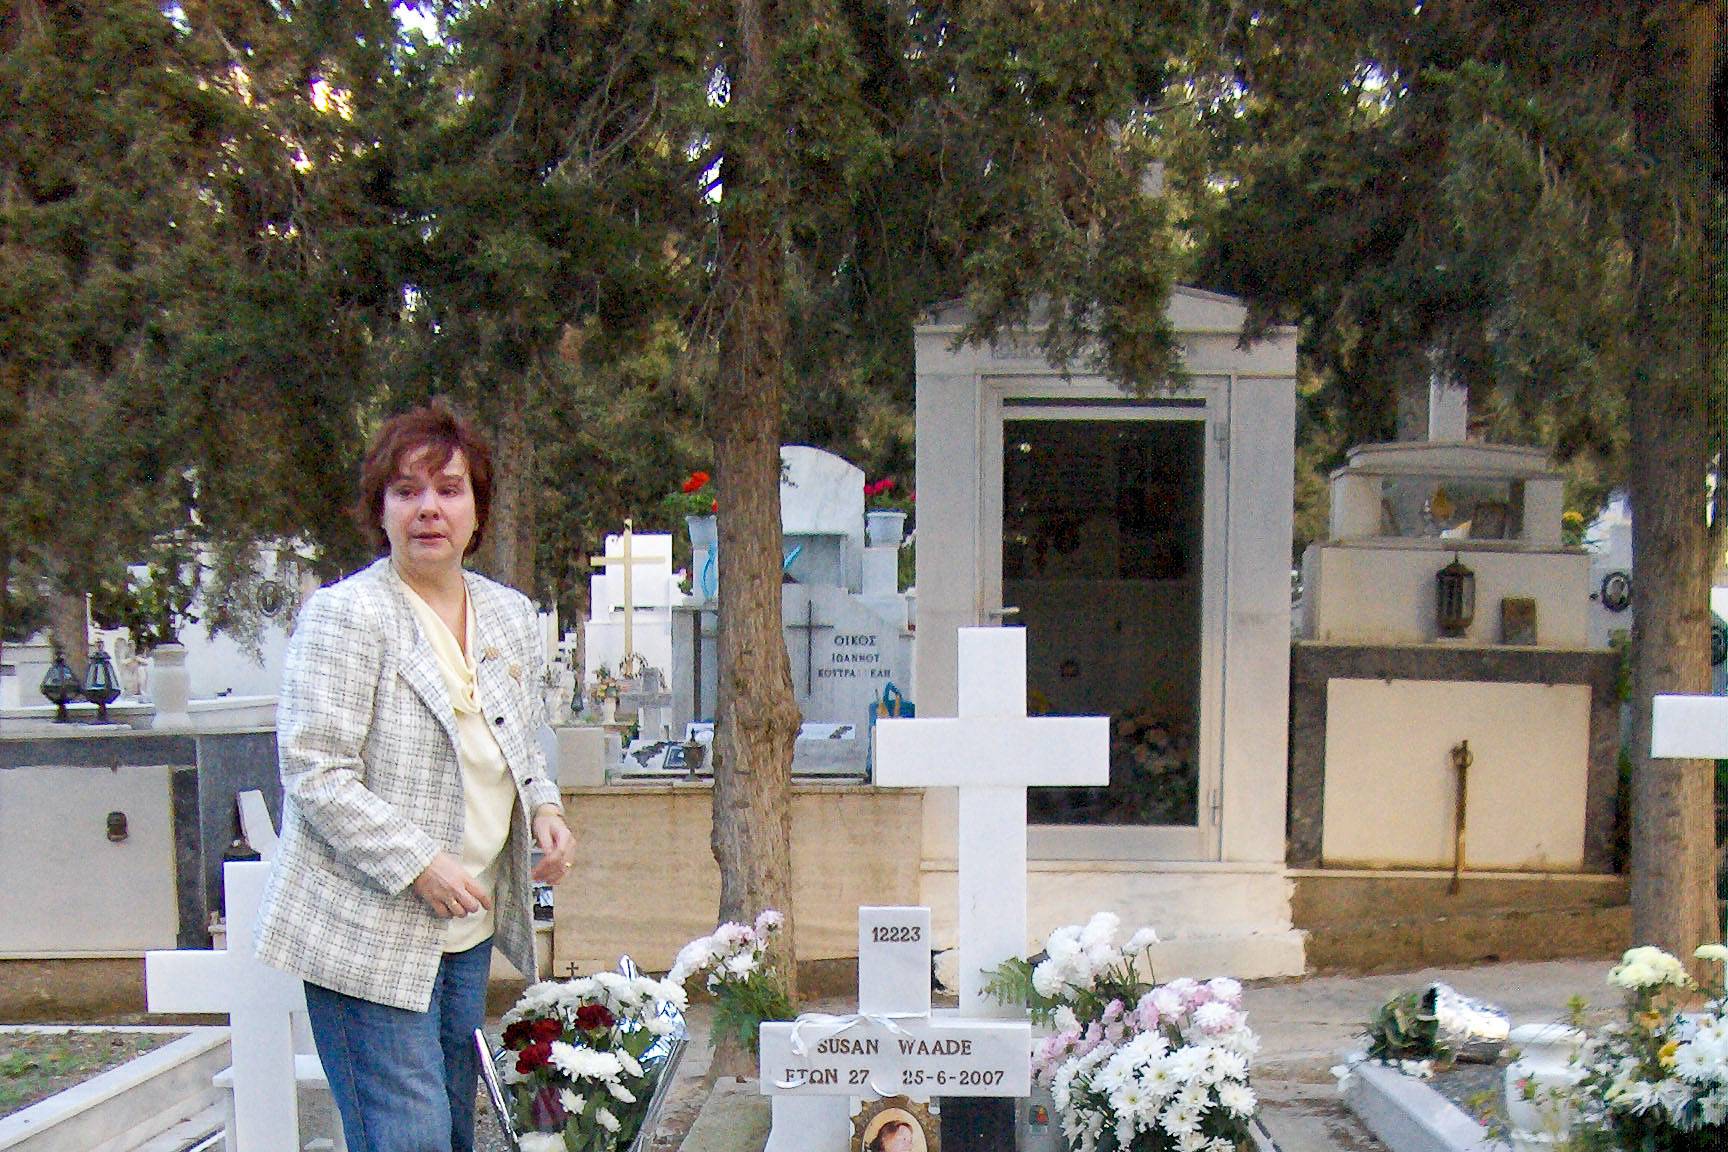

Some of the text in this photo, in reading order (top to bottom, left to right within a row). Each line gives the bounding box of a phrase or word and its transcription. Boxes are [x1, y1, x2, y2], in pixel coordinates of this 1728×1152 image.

[834, 635, 877, 647] ΟΙΚΟΣ
[872, 926, 921, 943] 12223
[817, 1038, 972, 1056] SUSAN WAADE
[849, 1069, 870, 1085] 27
[902, 1070, 1004, 1085] 25-6-2007
